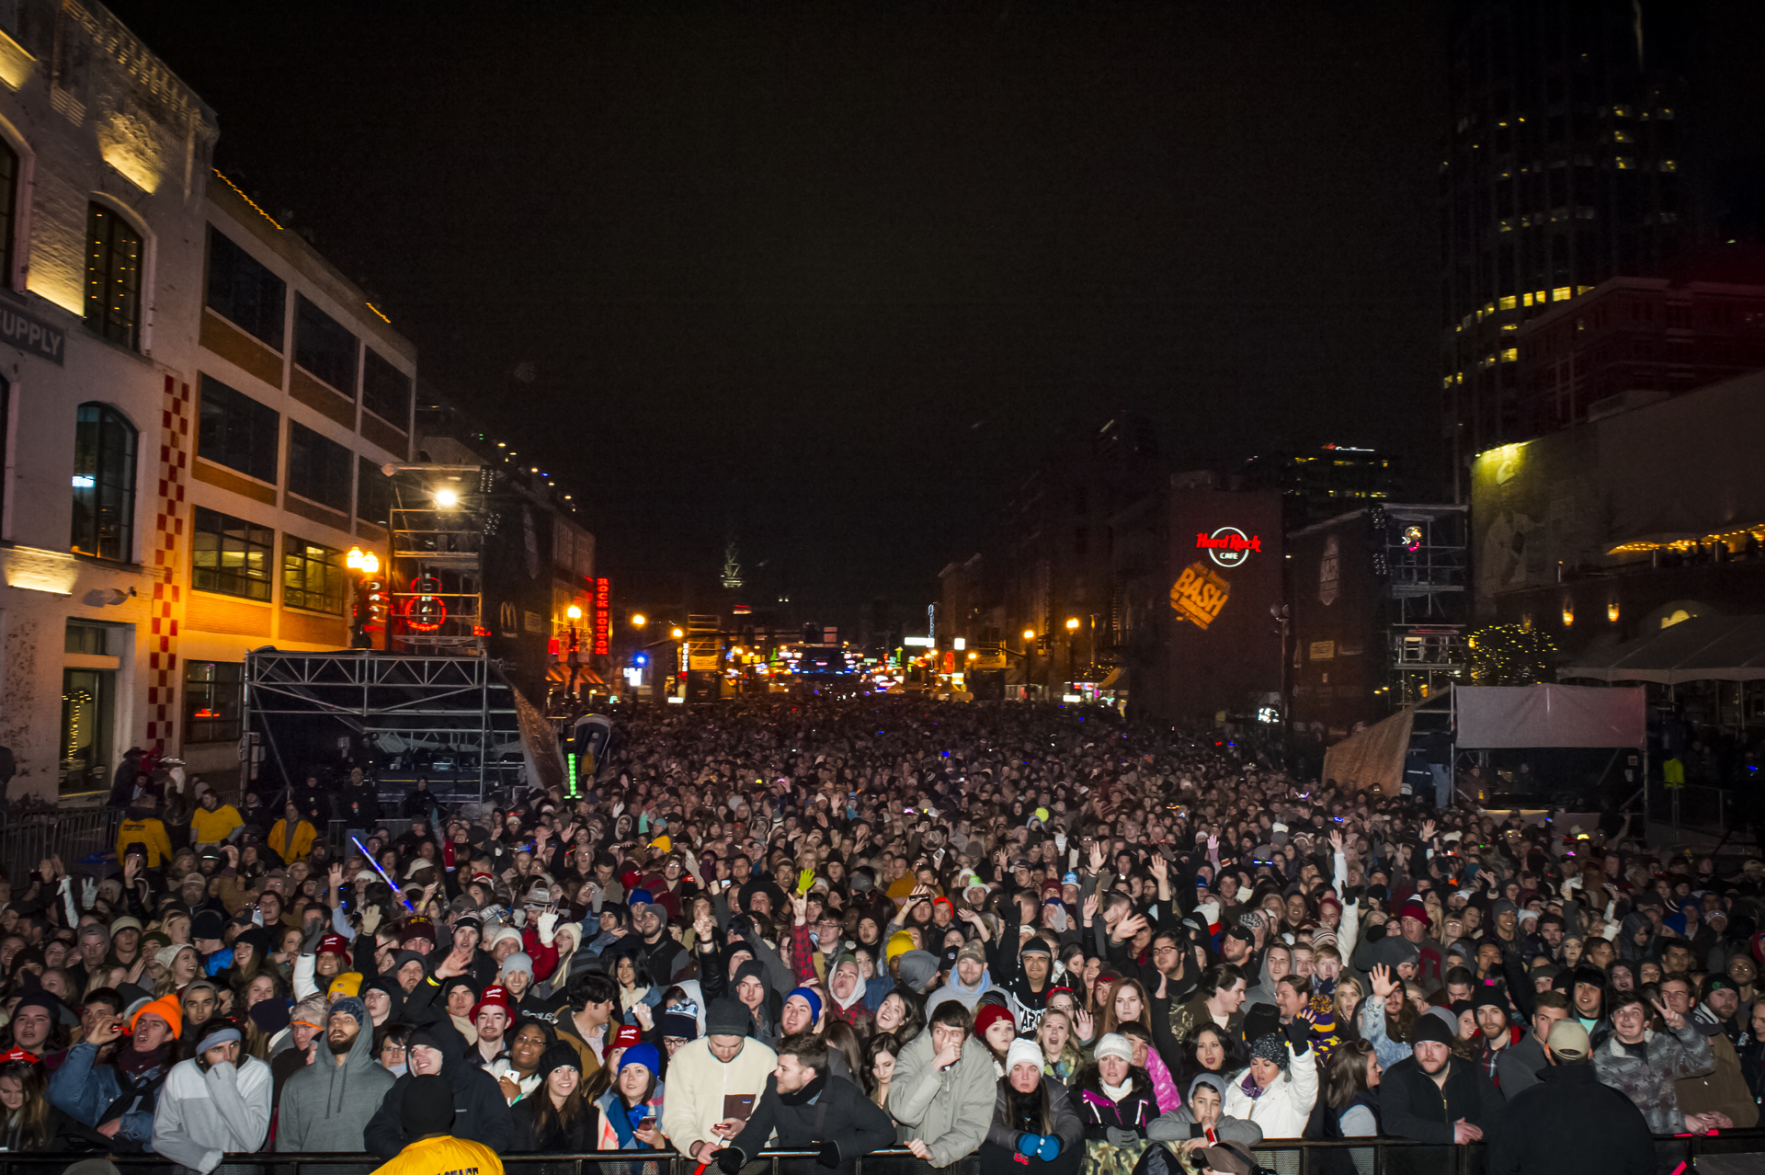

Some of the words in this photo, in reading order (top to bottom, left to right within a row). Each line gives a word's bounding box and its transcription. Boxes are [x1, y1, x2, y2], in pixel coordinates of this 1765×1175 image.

[0, 309, 62, 356] UPPLY
[1196, 532, 1229, 549] Hard
[1229, 533, 1262, 552] Rock
[1219, 552, 1239, 560] CAFE
[596, 577, 609, 607] ROCK
[1173, 567, 1228, 617] BASH
[595, 610, 608, 655] BOTTOM
